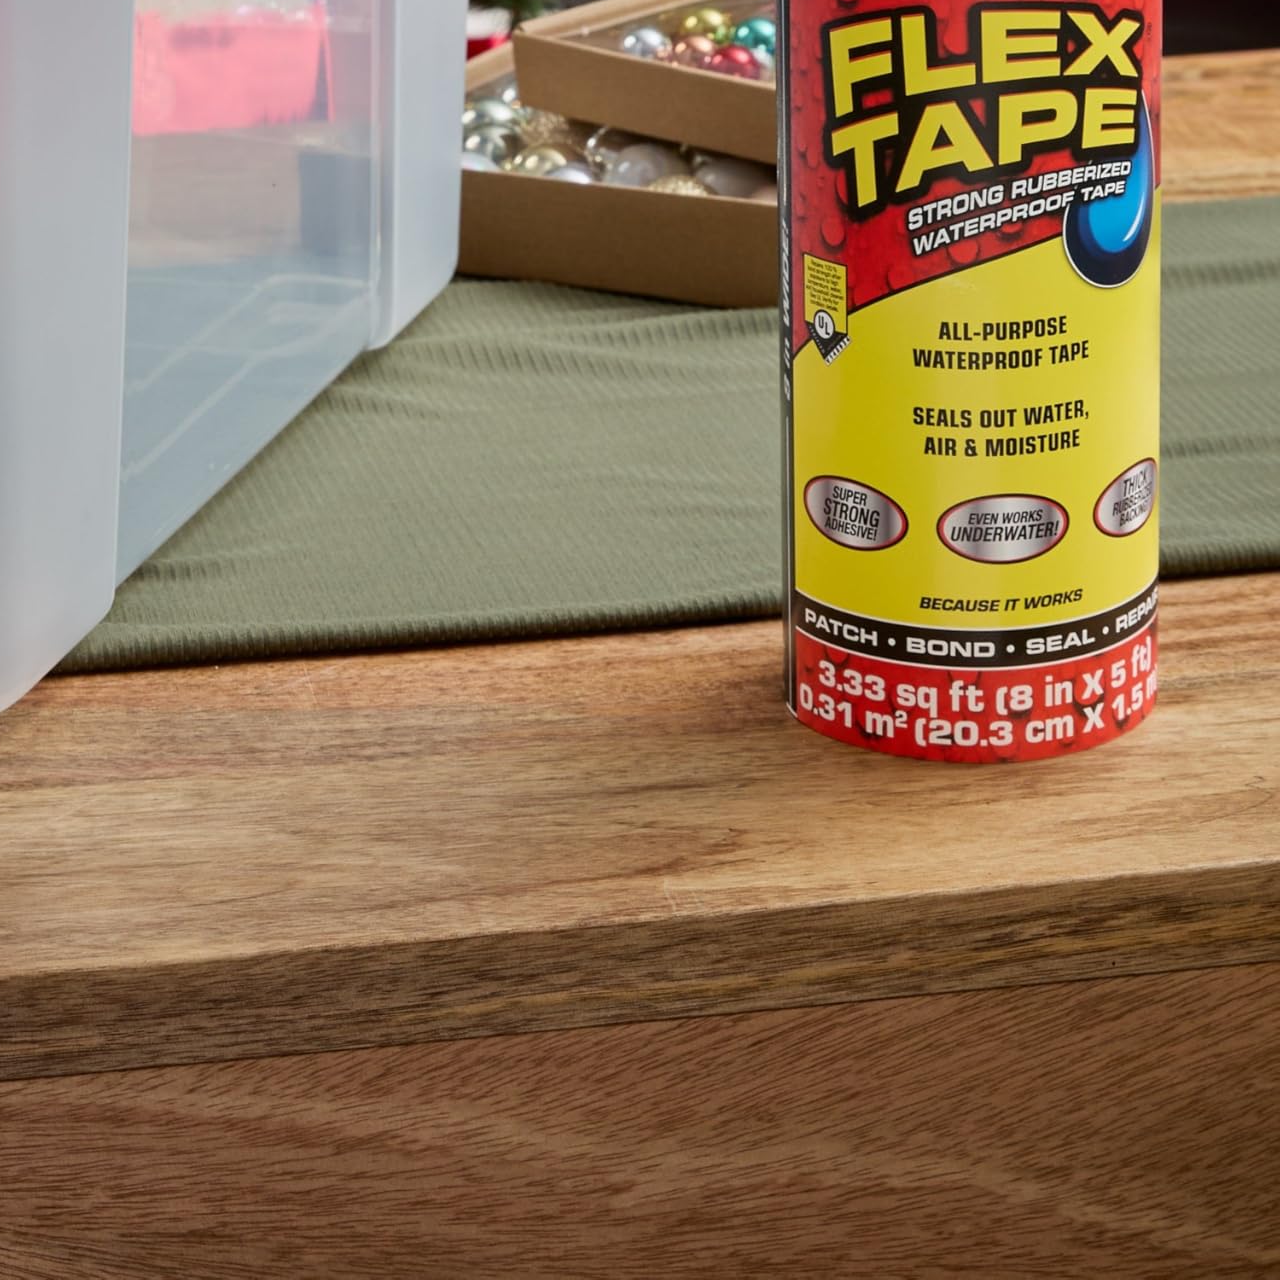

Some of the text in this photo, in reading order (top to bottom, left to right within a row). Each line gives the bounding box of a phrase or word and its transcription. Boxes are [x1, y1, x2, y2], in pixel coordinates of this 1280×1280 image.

[828, 7, 1142, 119] FLEX
[830, 86, 1138, 208] TAPE
[907, 160, 1132, 232] STRONG RUBBERIZED
[911, 181, 1126, 257] WATERPROOF TAPE
[818, 315, 830, 336] UL
[938, 315, 1067, 342] ALL-PURPOSE
[913, 340, 1090, 370] WATERPROOF TAPE
[913, 399, 1090, 429] SEALS OUT WATER,
[923, 429, 1081, 457] AIR & MOISTURE
[832, 485, 868, 507] SUPER
[1123, 468, 1148, 498] THICK
[823, 497, 880, 528] STRONG
[968, 508, 1043, 525] EVEN WORKS
[824, 516, 878, 541] ADHESIVE!
[950, 520, 1060, 543] UNDERWATER!
[919, 589, 1083, 612] BECAUSE IT WORKS
[805, 607, 879, 647] PATCH
[906, 637, 996, 658] BOND
[1025, 630, 1096, 655] SEAL
[819, 660, 887, 702] 3.33
[896, 685, 939, 719] sq
[949, 681, 985, 712] ft
[996, 684, 1034, 716] (8
[1044, 676, 1073, 707] in
[1110, 659, 1127, 689] 5
[1131, 635, 1152, 679] ft)
[799, 684, 854, 728] 0.31
[914, 720, 1014, 747] (20.3
[1025, 715, 1074, 743] cm
[1111, 681, 1144, 721] 1.5
